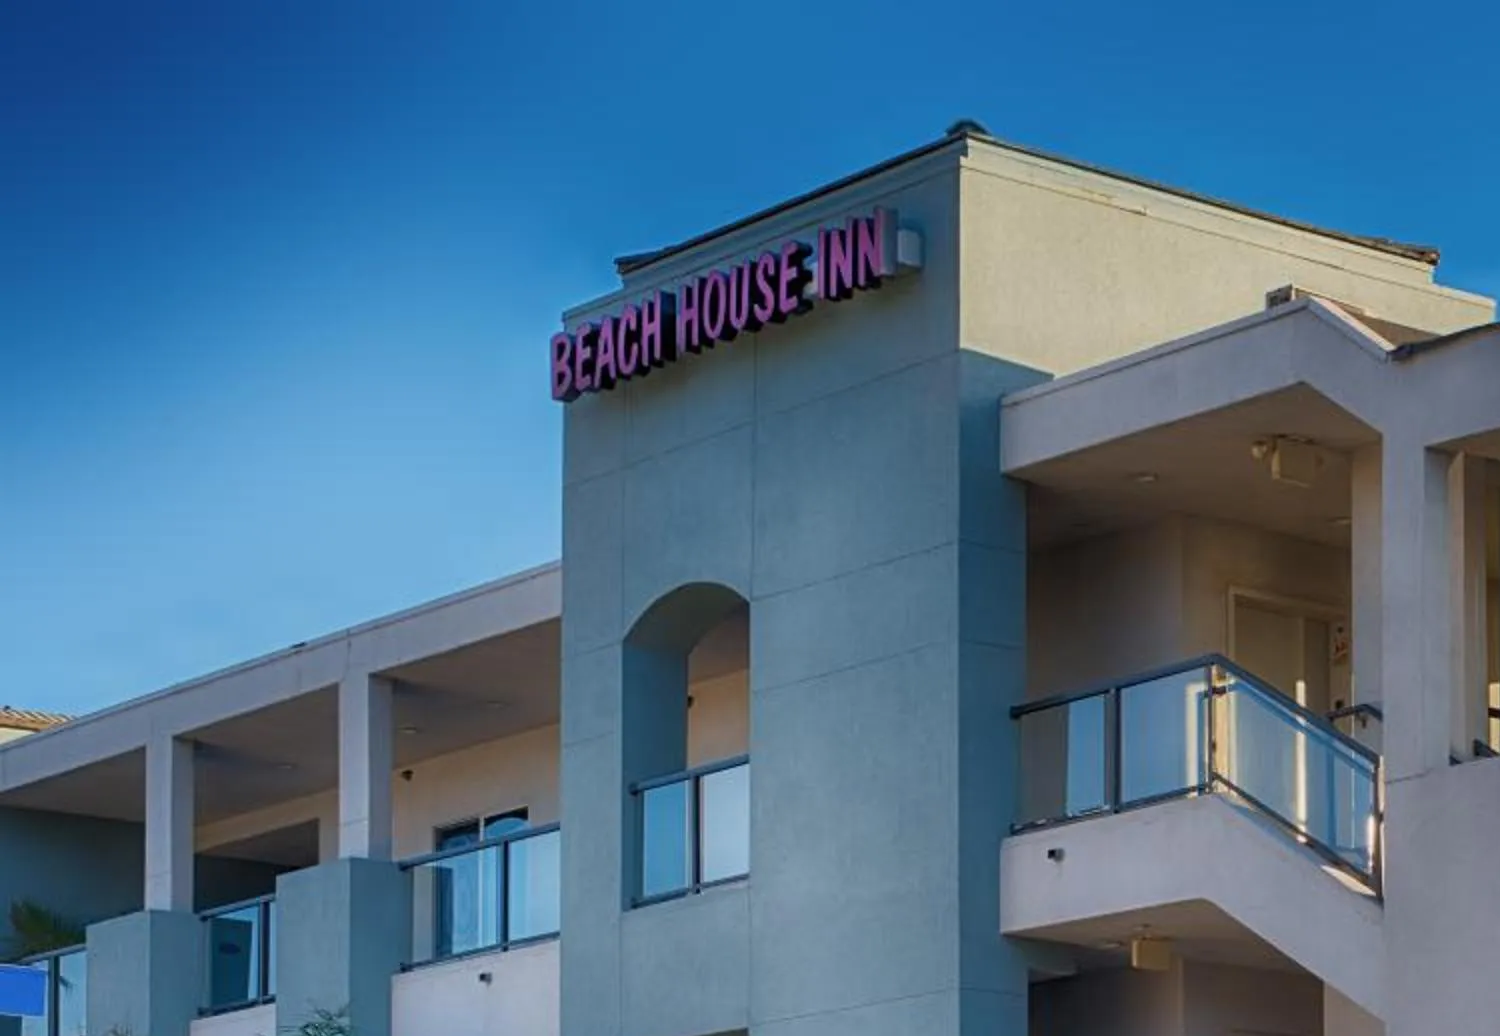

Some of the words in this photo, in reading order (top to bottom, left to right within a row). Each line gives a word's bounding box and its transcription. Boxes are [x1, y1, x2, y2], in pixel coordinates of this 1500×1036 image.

[551, 290, 662, 400] BEACH
[676, 240, 800, 355] HOUSE
[817, 206, 885, 299] INN
